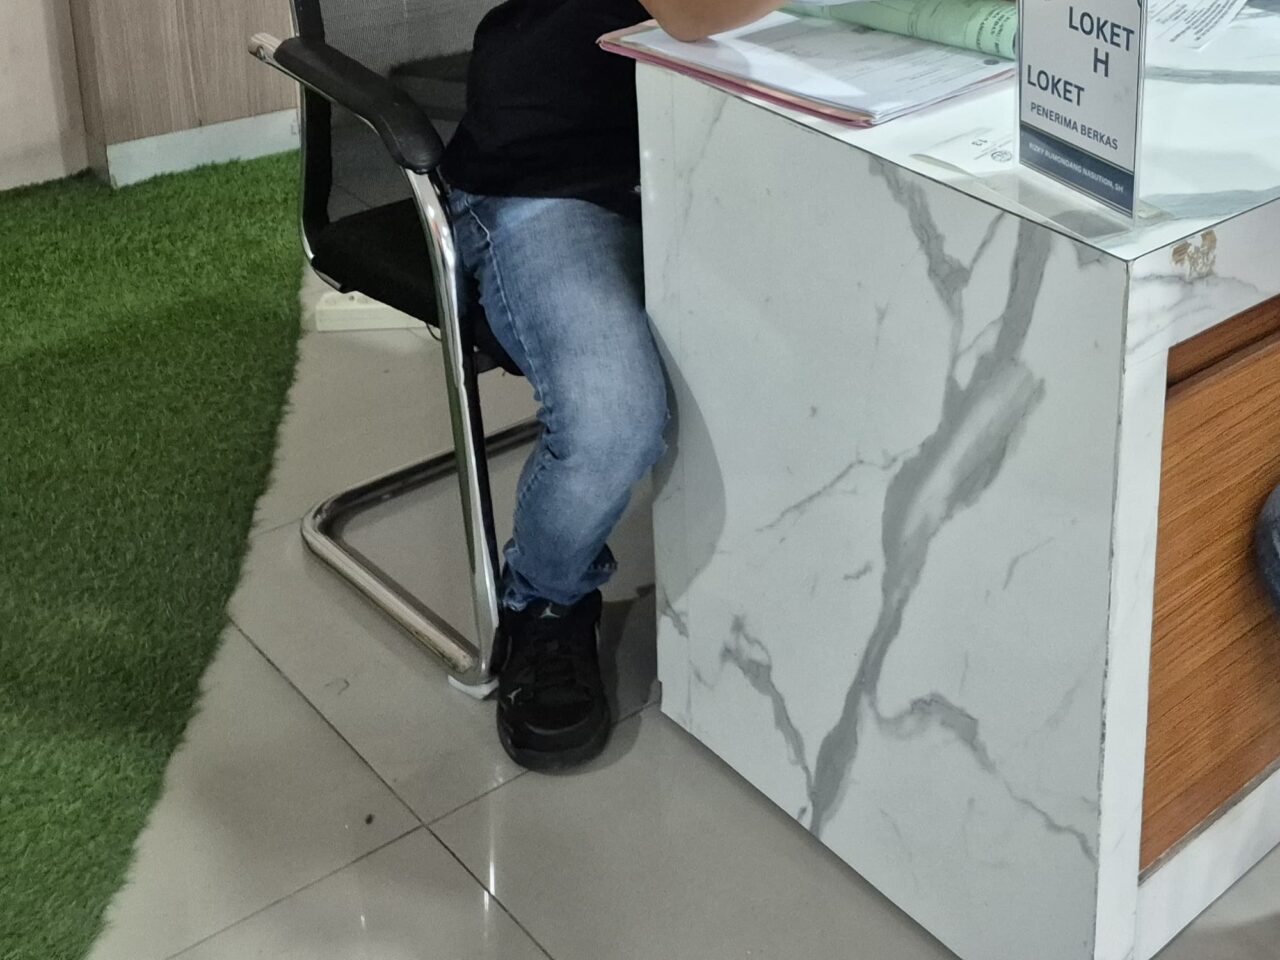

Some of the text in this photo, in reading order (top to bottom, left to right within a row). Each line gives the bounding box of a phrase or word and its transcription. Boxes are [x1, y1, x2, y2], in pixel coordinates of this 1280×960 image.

[1069, 6, 1135, 52] LOKET
[1093, 47, 1110, 77] H
[1027, 64, 1085, 107] LOKET
[1030, 102, 1119, 150] PENERIMA BERKAS
